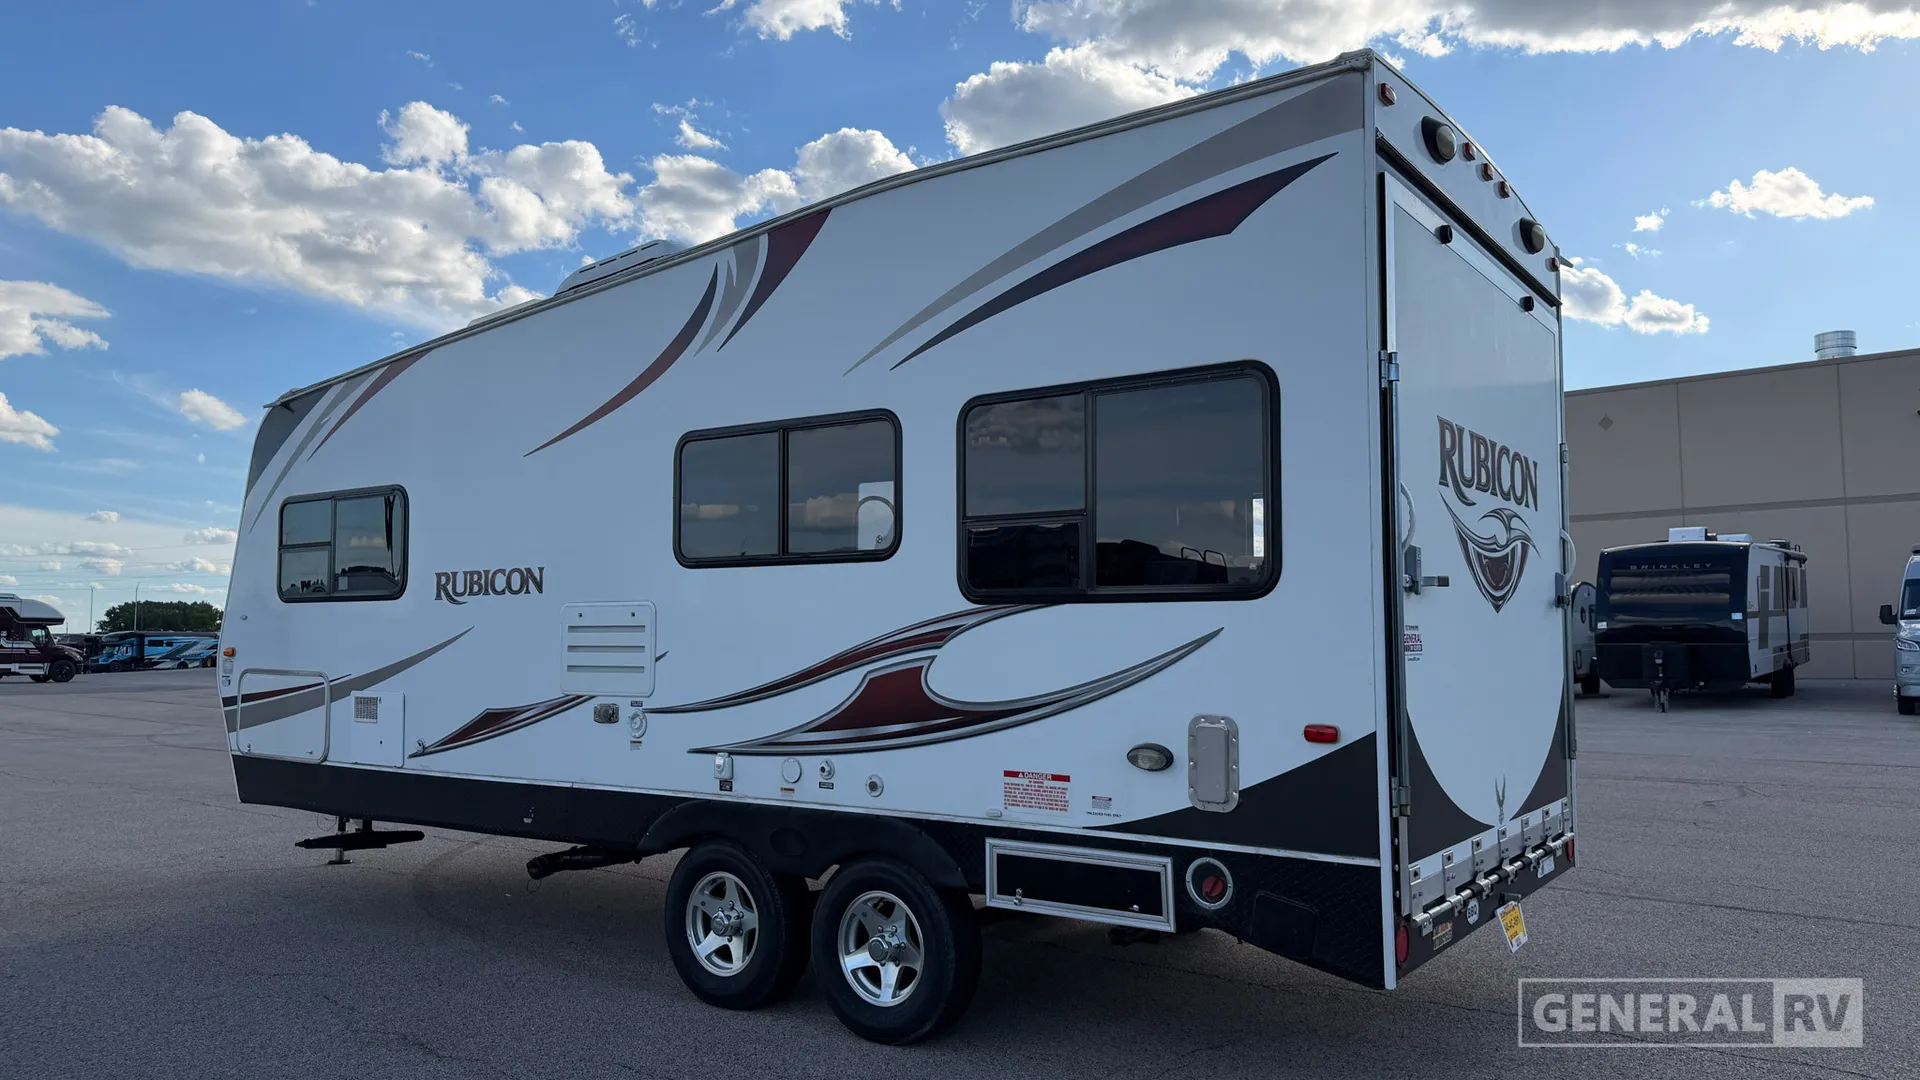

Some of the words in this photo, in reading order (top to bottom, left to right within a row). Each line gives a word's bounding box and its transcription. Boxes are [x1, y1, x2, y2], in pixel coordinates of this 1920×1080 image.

[1437, 415, 1538, 512] RUBICON
[434, 567, 545, 605] RUBICON
[1024, 772, 1052, 780] DANGER
